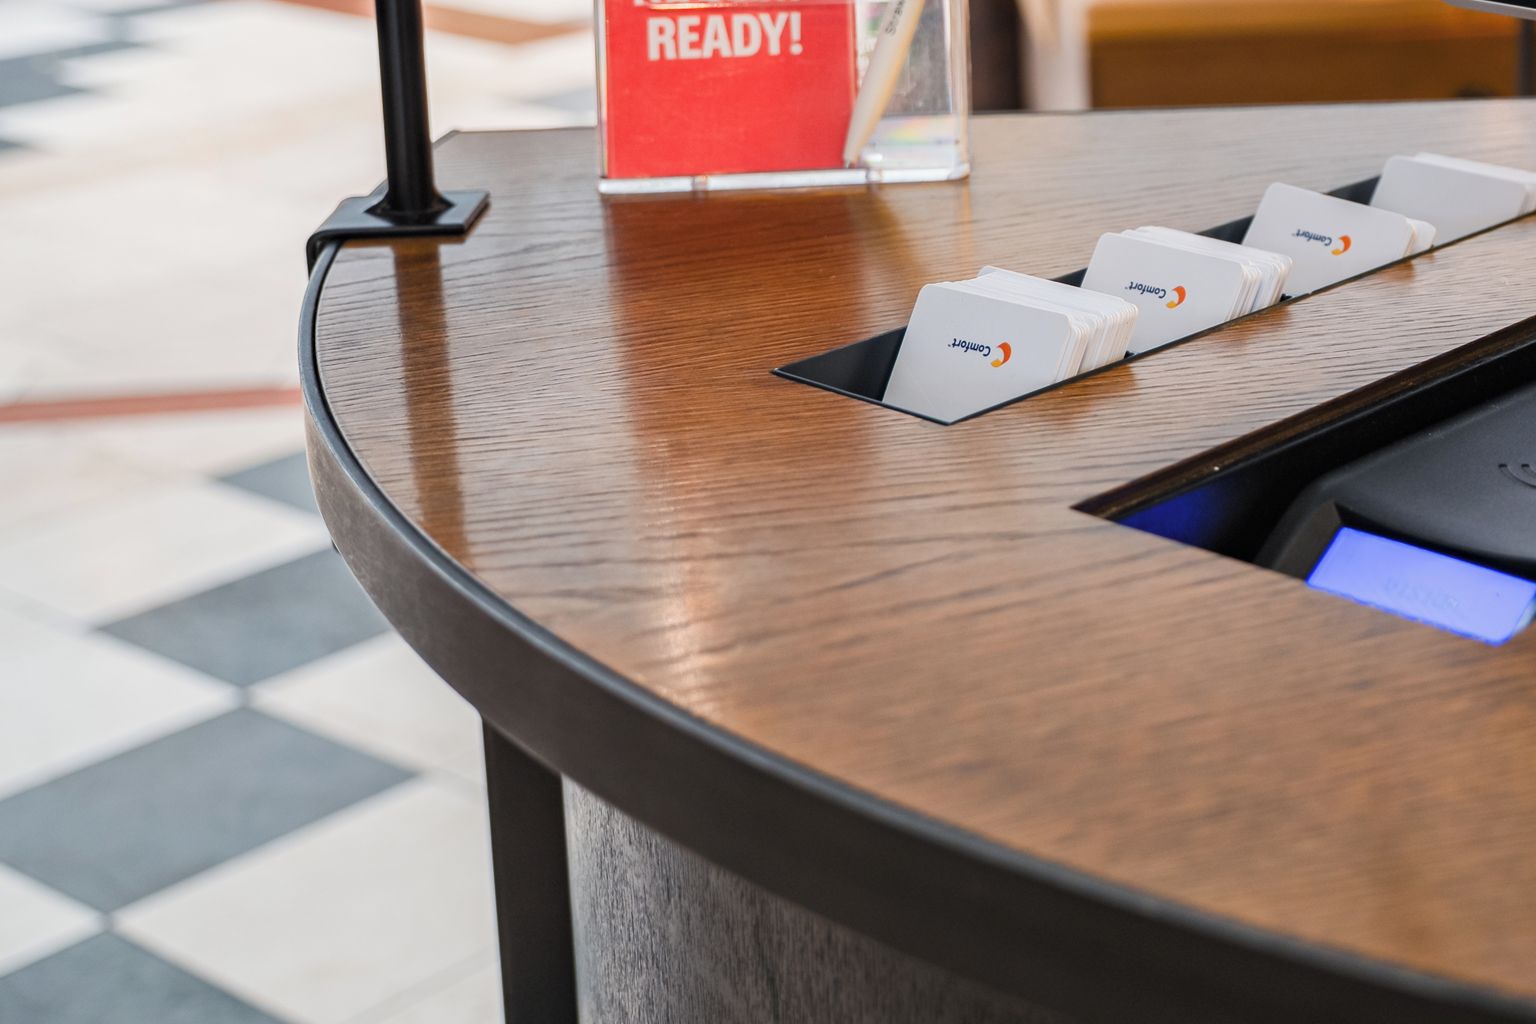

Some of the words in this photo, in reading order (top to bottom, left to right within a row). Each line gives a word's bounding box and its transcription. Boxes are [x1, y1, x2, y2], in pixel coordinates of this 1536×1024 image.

[647, 12, 804, 62] READY!
[1296, 228, 1333, 247] Comfort
[1129, 281, 1167, 299] Comfort
[951, 338, 991, 357] Comfort
